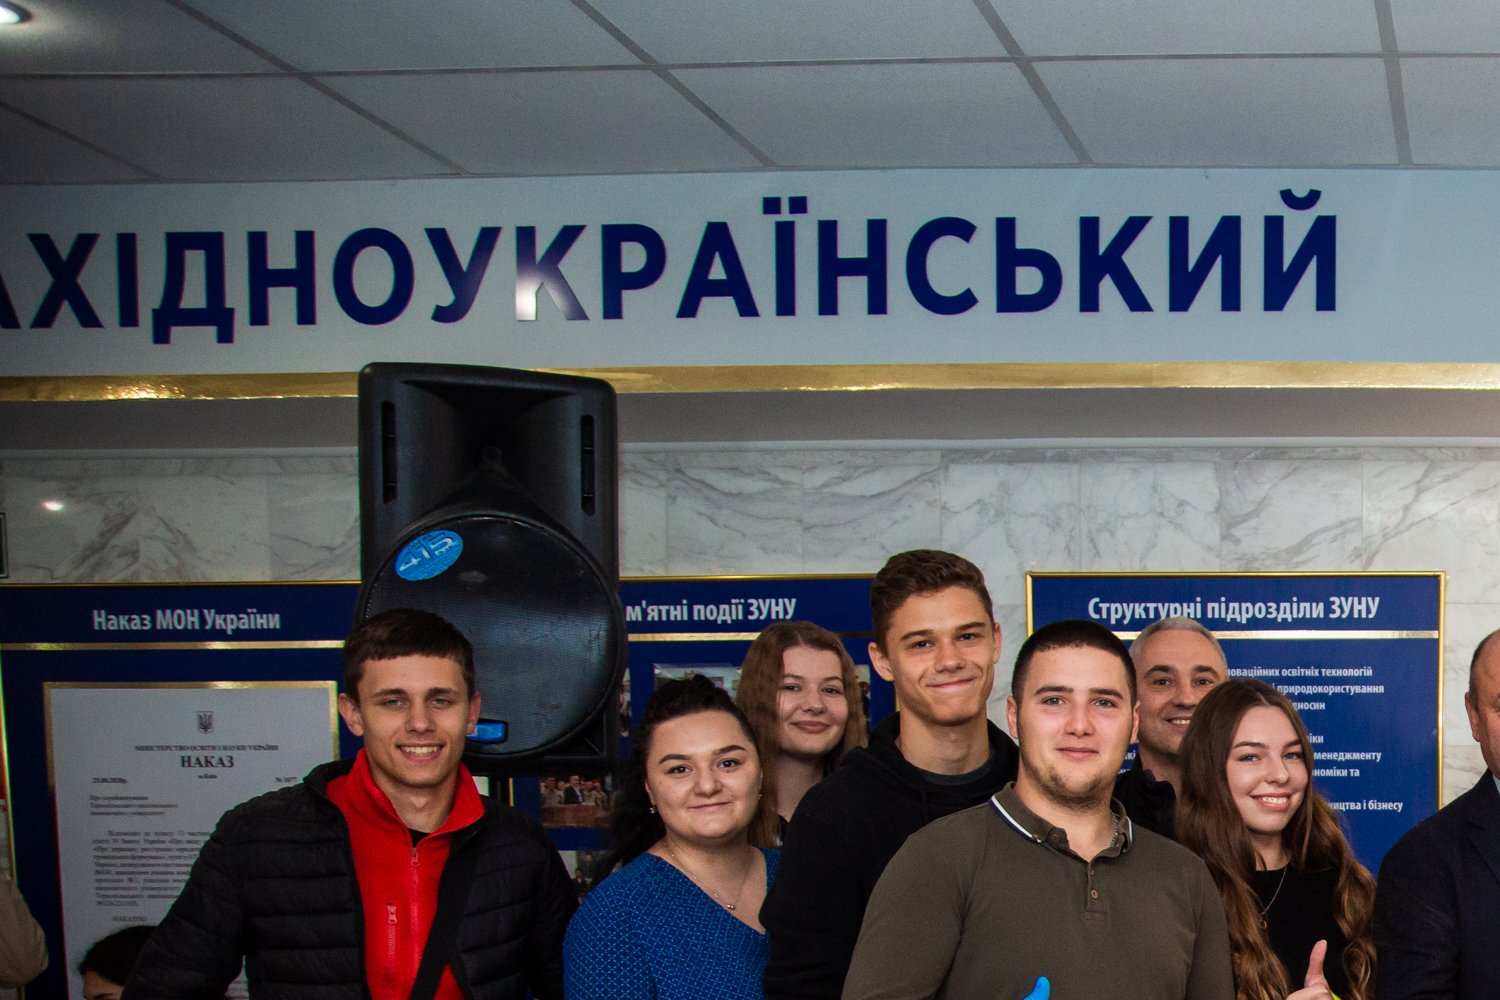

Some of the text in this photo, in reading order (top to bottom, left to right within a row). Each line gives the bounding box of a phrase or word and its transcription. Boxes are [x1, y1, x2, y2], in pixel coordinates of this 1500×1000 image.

[626, 598, 797, 624] м'ятні події ЗУНУ
[1088, 596, 1380, 624] Структурні підрозділи ЗУНУ
[93, 608, 281, 634] Наказ МОН України
[1281, 666, 1319, 677] освітніх
[1321, 666, 1373, 677] технологій
[1277, 684, 1384, 695] природокористування
[1289, 700, 1326, 711] дносин
[1306, 733, 1324, 743] іки
[181, 755, 235, 768] НАКАЗ
[1313, 752, 1381, 763] менеджменту
[1349, 768, 1360, 777] та
[1369, 799, 1403, 811] бізнесу
